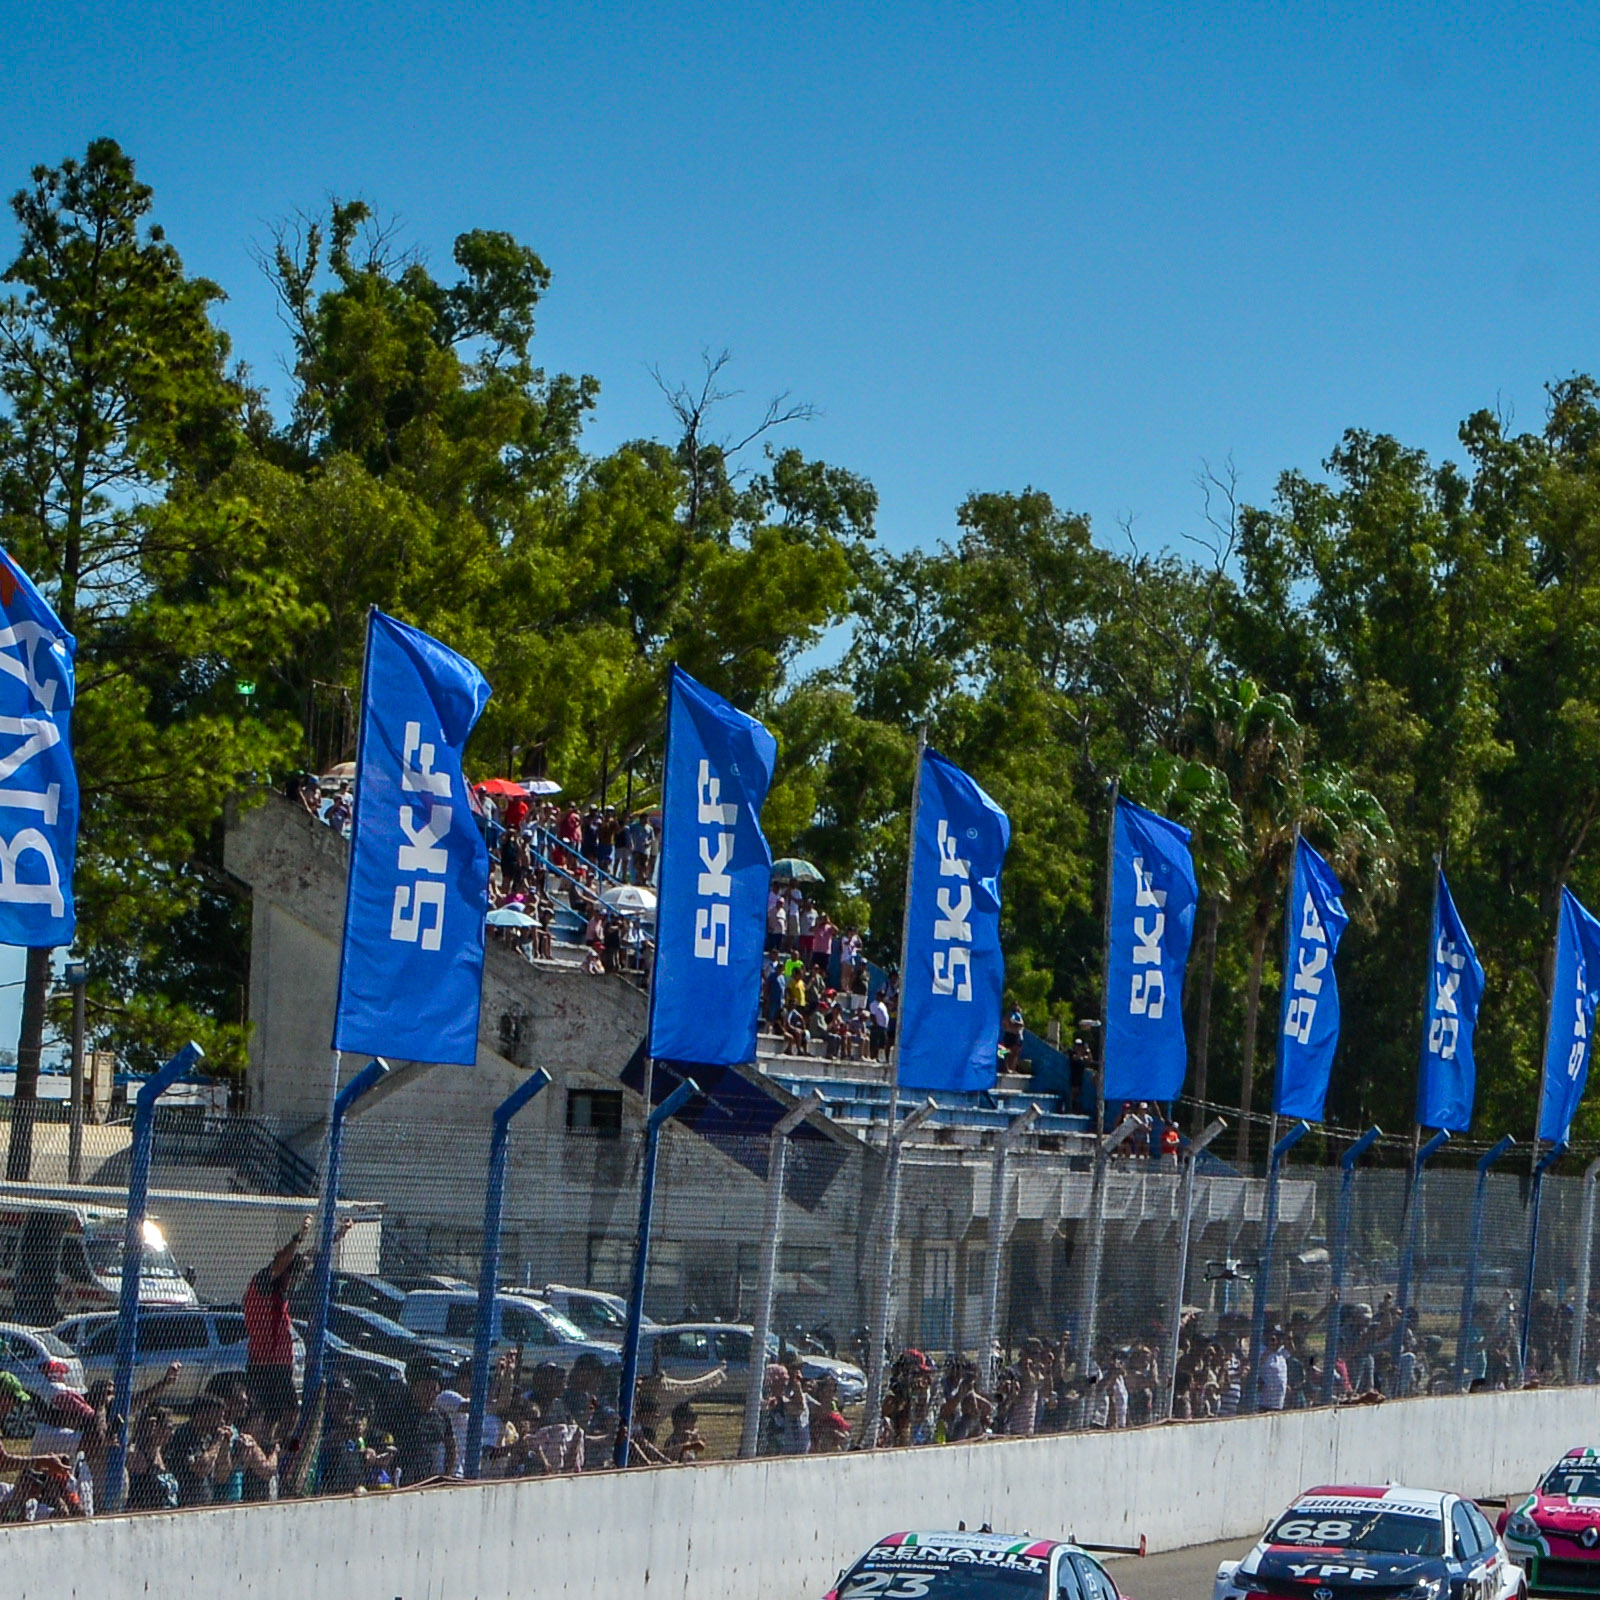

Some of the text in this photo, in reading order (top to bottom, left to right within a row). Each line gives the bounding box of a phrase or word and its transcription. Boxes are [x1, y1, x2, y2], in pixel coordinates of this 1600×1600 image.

[390, 720, 452, 951] SKF
[694, 758, 738, 967] SKF
[931, 818, 973, 1002] SKF
[1129, 856, 1167, 1020] SKF
[1283, 890, 1330, 1045] SKF
[1428, 926, 1466, 1060] SKF
[868, 1546, 1049, 1568] RENAULT
[1277, 1519, 1353, 1541] 68
[1288, 1564, 1379, 1581] YPF
[1303, 1499, 1439, 1516] BRIDGESTONE
[847, 1572, 936, 1599] 23
